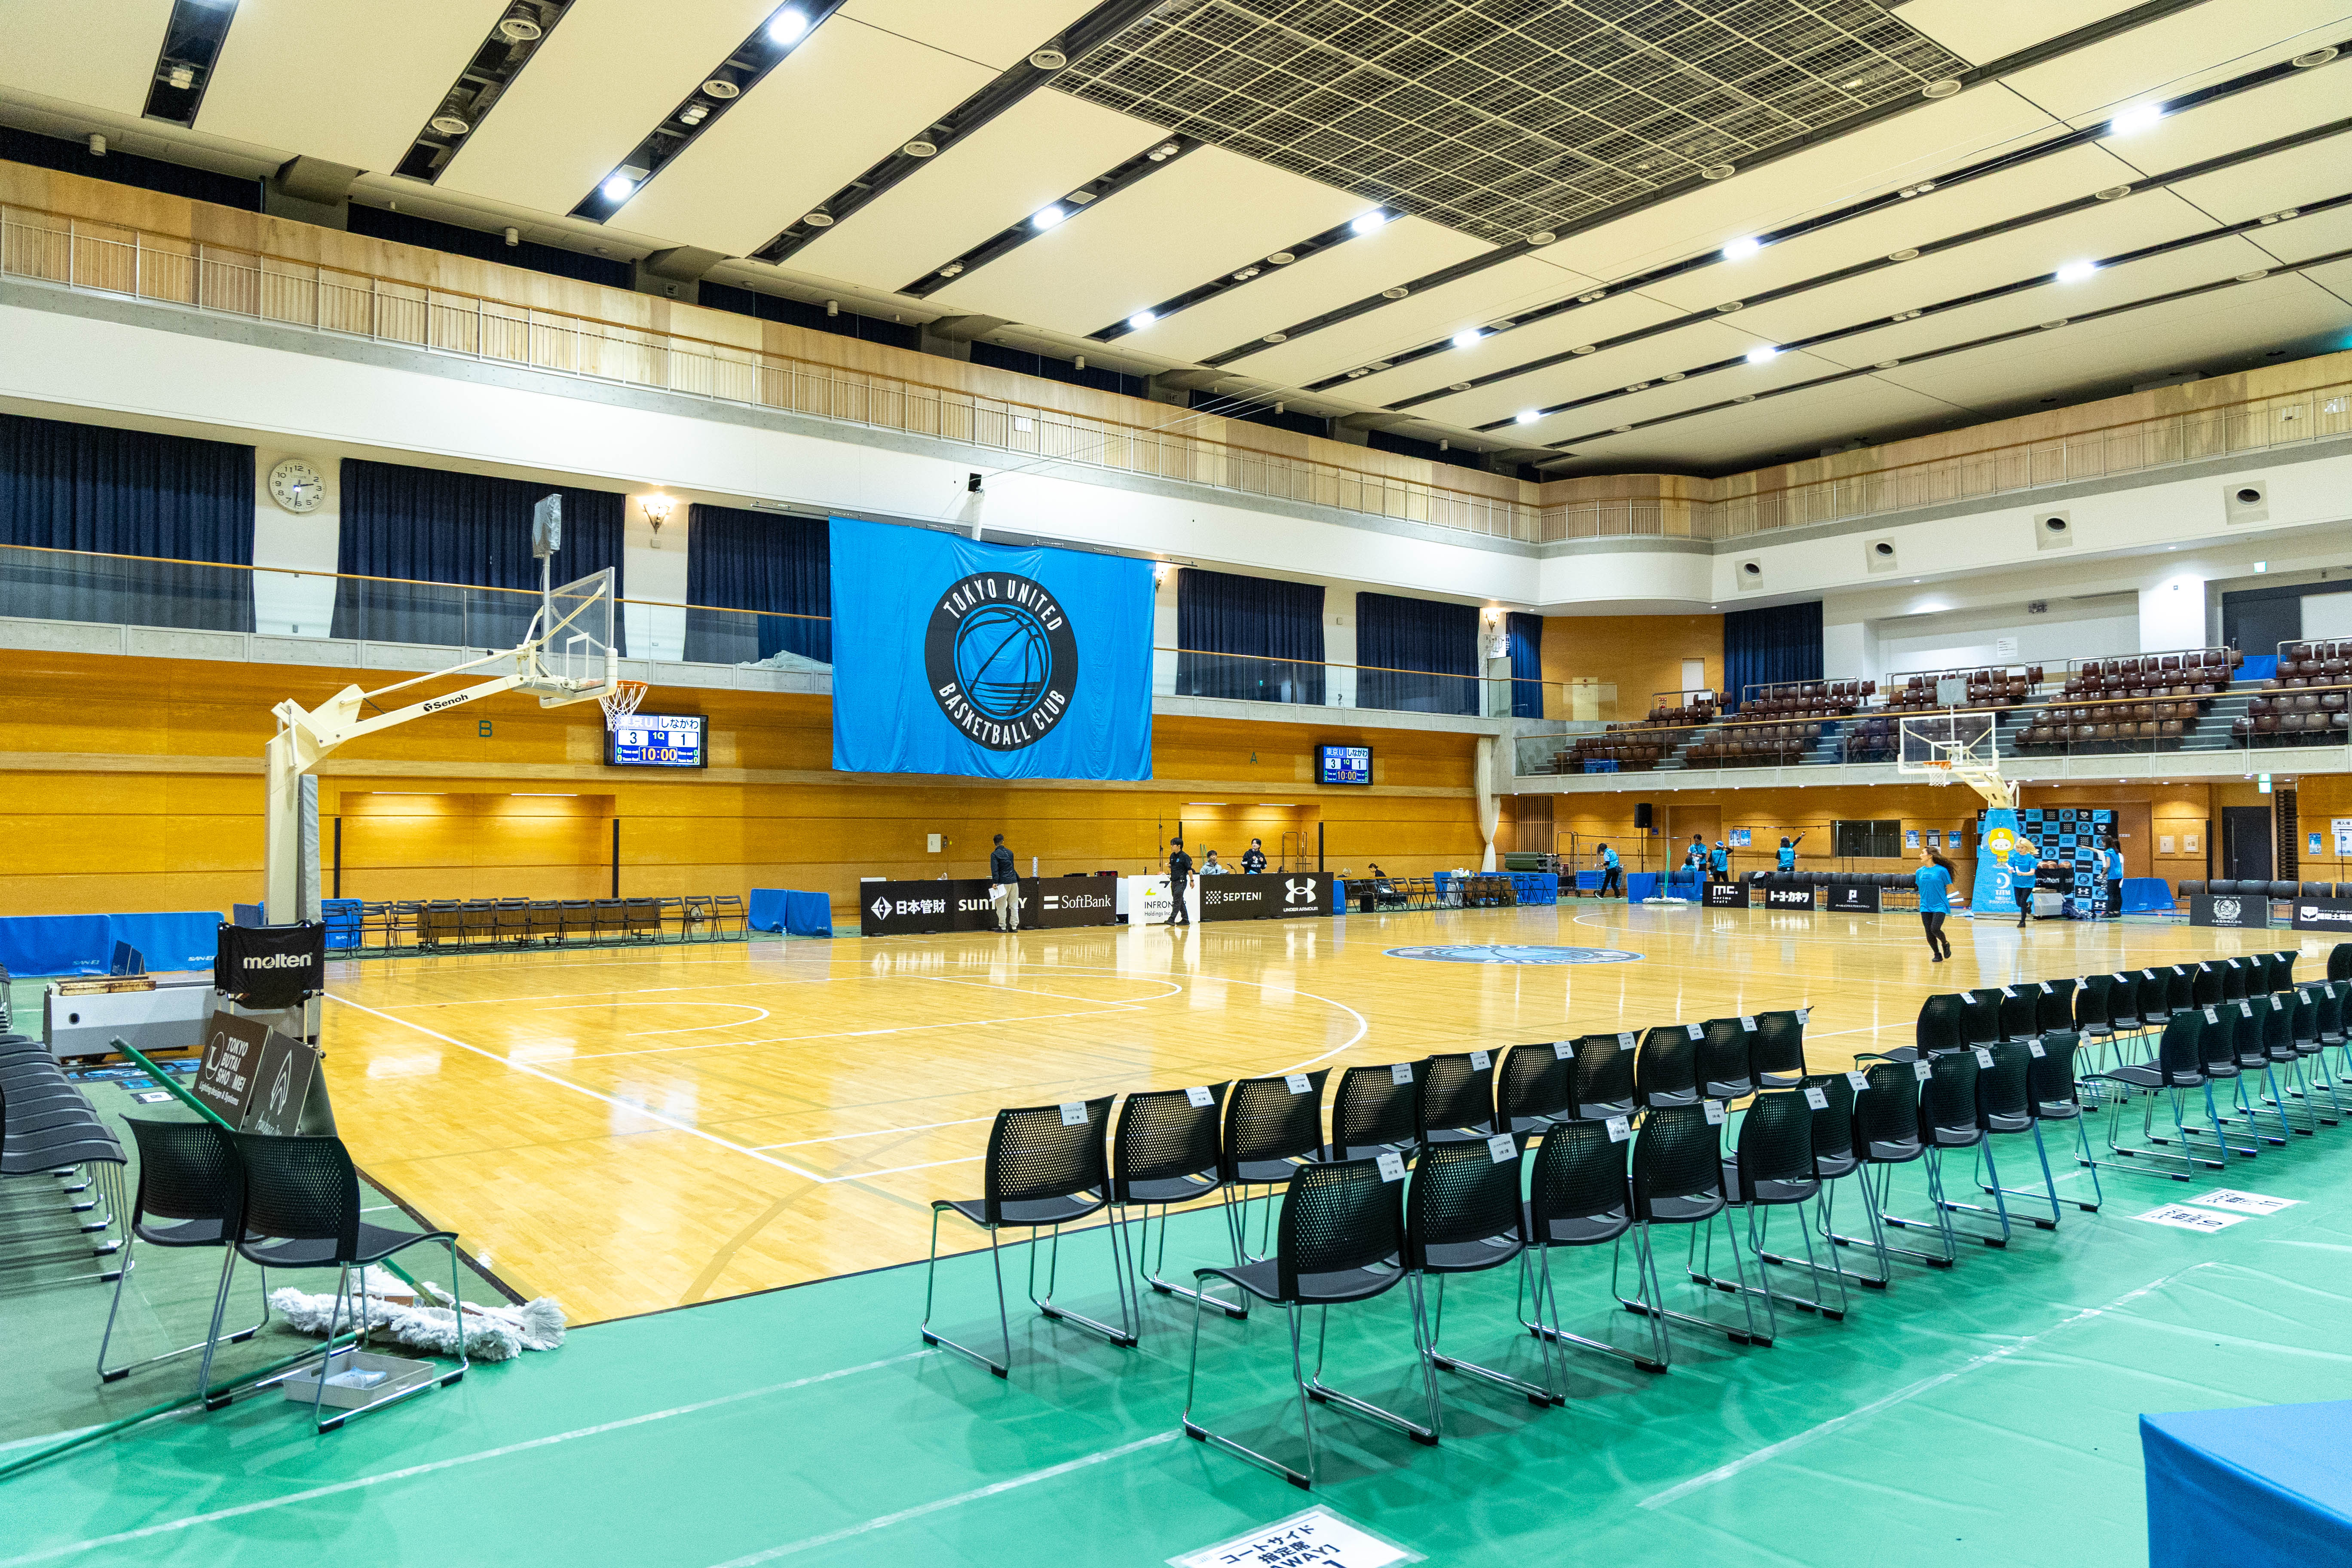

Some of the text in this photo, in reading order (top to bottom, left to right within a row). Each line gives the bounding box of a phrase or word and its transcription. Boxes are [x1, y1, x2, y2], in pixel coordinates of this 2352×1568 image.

[943, 578, 1062, 631] TOKYO UNITED
[433, 694, 469, 709] Senoh
[939, 682, 1066, 745] BASKETBALL CLUB
[479, 720, 493, 737] B
[662, 718, 698, 729] しながわ
[630, 732, 637, 744] 3
[681, 734, 685, 746] 1
[641, 748, 677, 761] 10:00
[1250, 752, 1258, 764] A
[1331, 759, 1335, 768] 3
[1358, 760, 1361, 769] 1
[1338, 771, 1356, 780] 10:00
[1062, 894, 1112, 909] SoftBank
[1223, 892, 1262, 902] SEPTENI
[1770, 891, 1809, 903] トーヨーカネツ
[896, 899, 946, 915] 日本管財
[243, 952, 311, 969] molten
[227, 1037, 248, 1057] TOKYO
[220, 1053, 241, 1072] BUTAI
[216, 1068, 246, 1092] SHO MEI
[1219, 1525, 1314, 1564] コートサイド
[1257, 1541, 1311, 1564] 指定席
